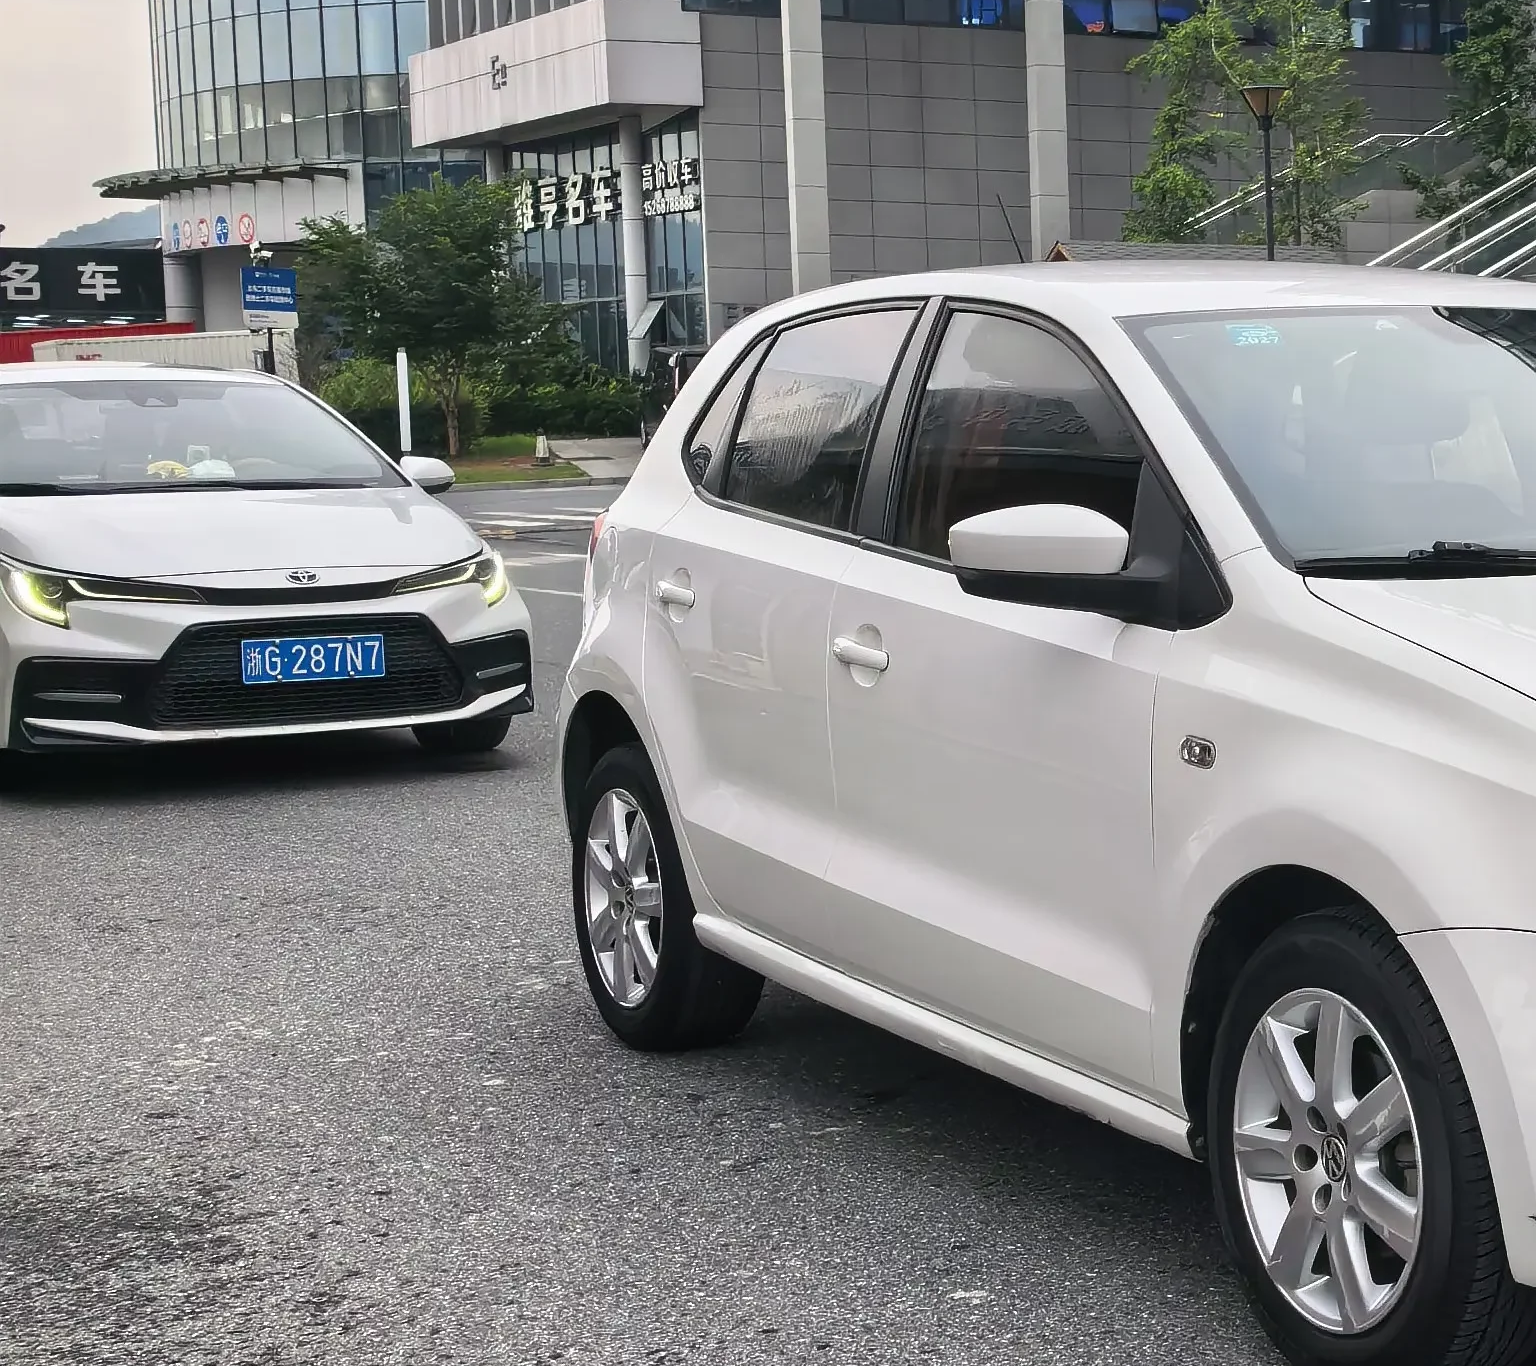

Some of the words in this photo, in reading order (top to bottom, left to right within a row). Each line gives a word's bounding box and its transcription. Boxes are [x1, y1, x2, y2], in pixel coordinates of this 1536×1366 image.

[641, 156, 693, 191] 高价收车
[0, 261, 121, 302] 名车
[247, 641, 380, 677] 浙G·287N7
